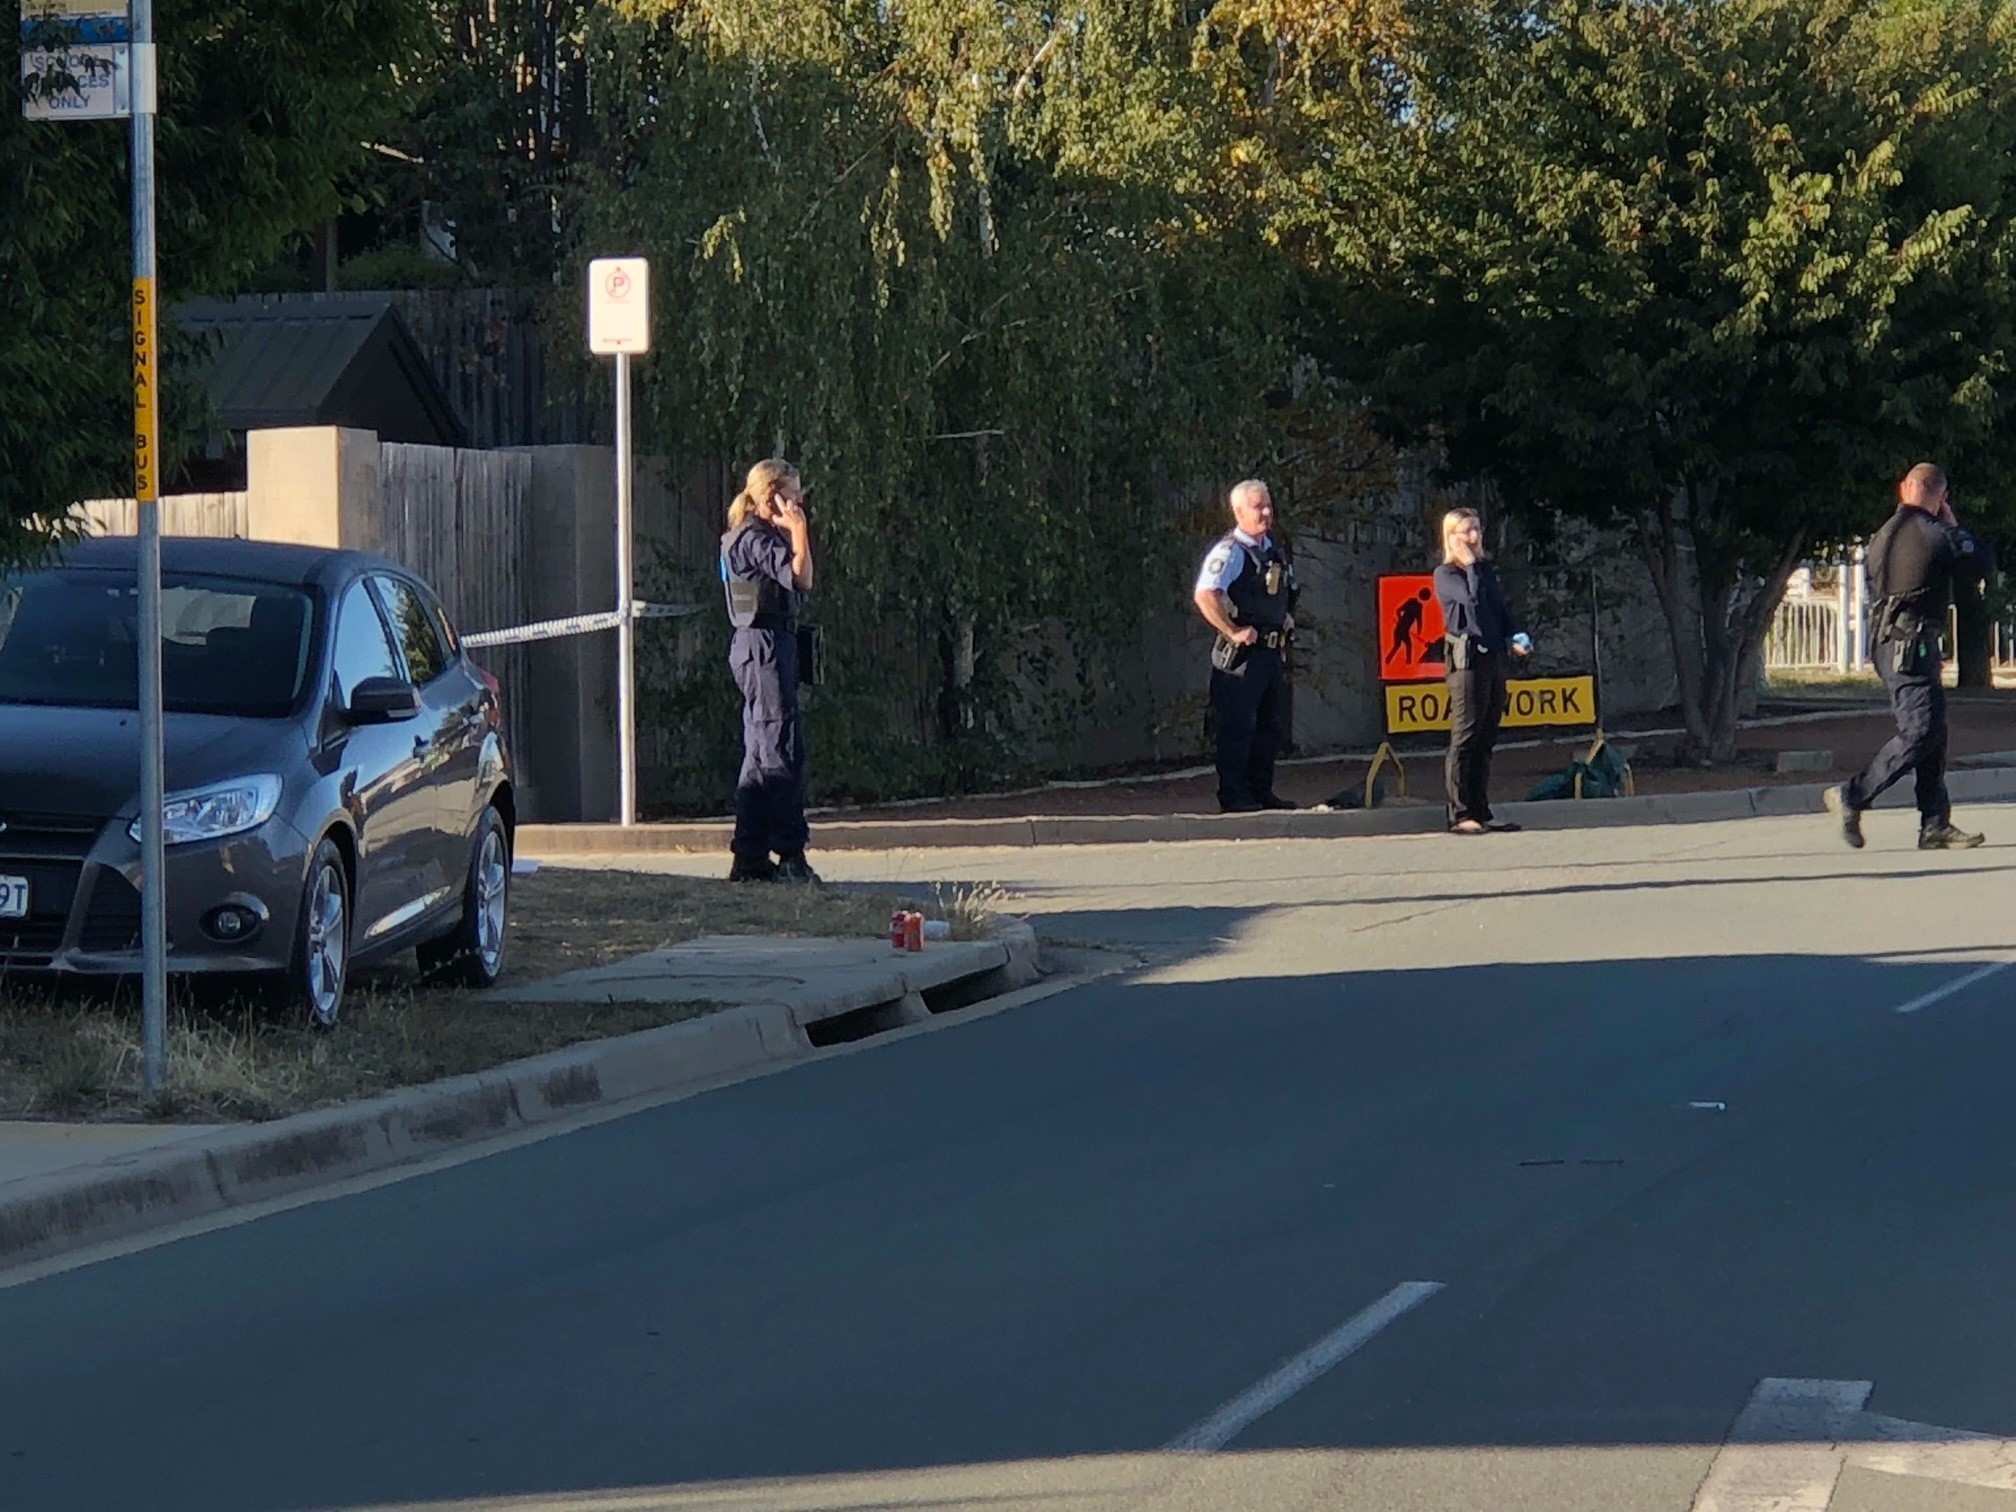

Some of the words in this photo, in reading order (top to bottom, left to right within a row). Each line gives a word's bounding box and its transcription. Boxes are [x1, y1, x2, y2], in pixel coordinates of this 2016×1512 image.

[49, 94, 90, 110] ONLY
[134, 289, 147, 410] SIGNAL
[136, 434, 148, 491] BUS
